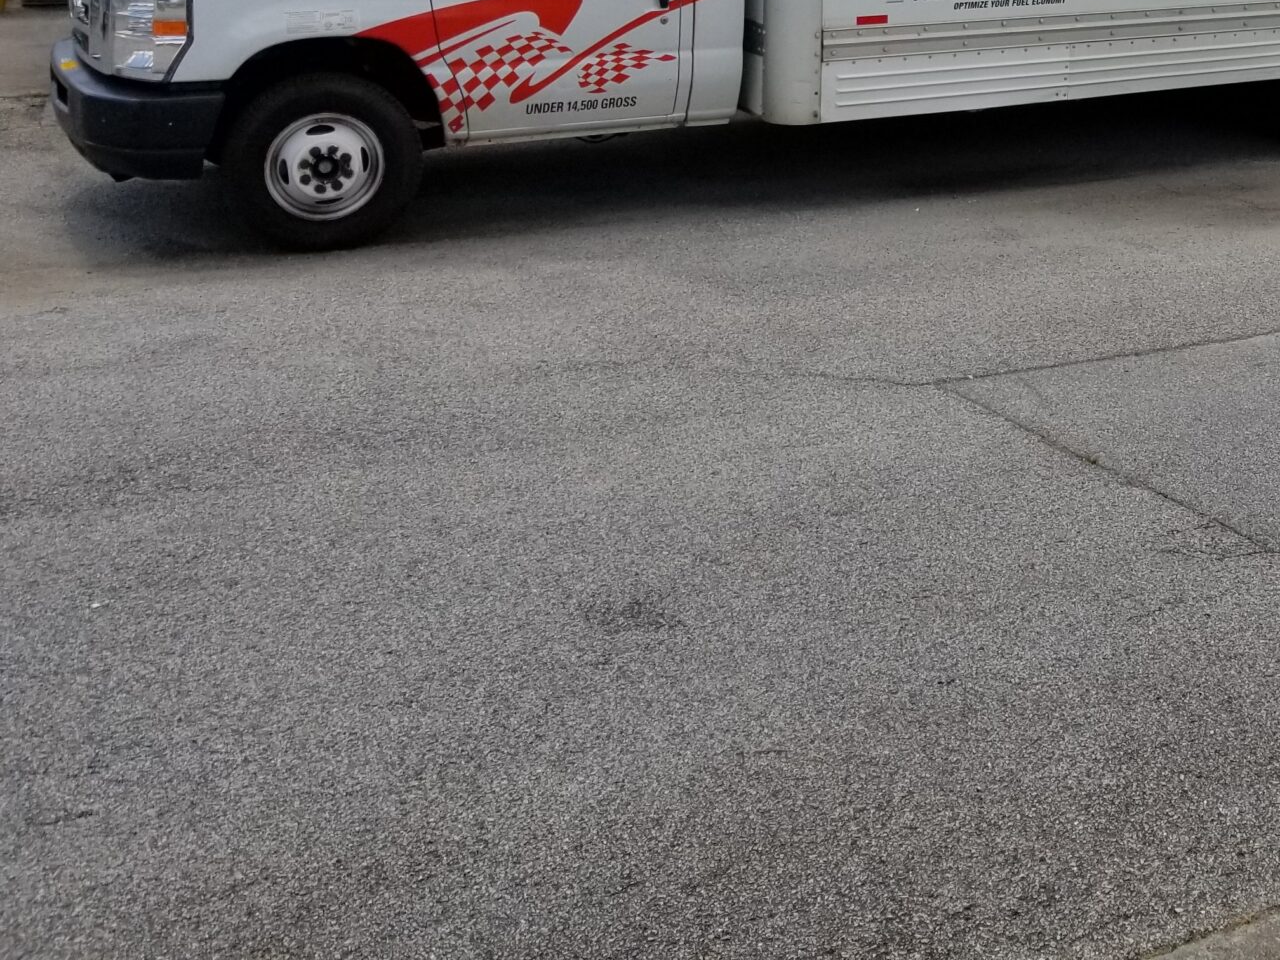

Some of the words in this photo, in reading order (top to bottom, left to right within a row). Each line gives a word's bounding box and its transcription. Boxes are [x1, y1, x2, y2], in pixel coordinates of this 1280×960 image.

[953, 0, 988, 10] OPTIMIZE
[525, 102, 564, 115] UNDER
[567, 99, 598, 112] 14,500
[601, 96, 637, 109] GROSS
